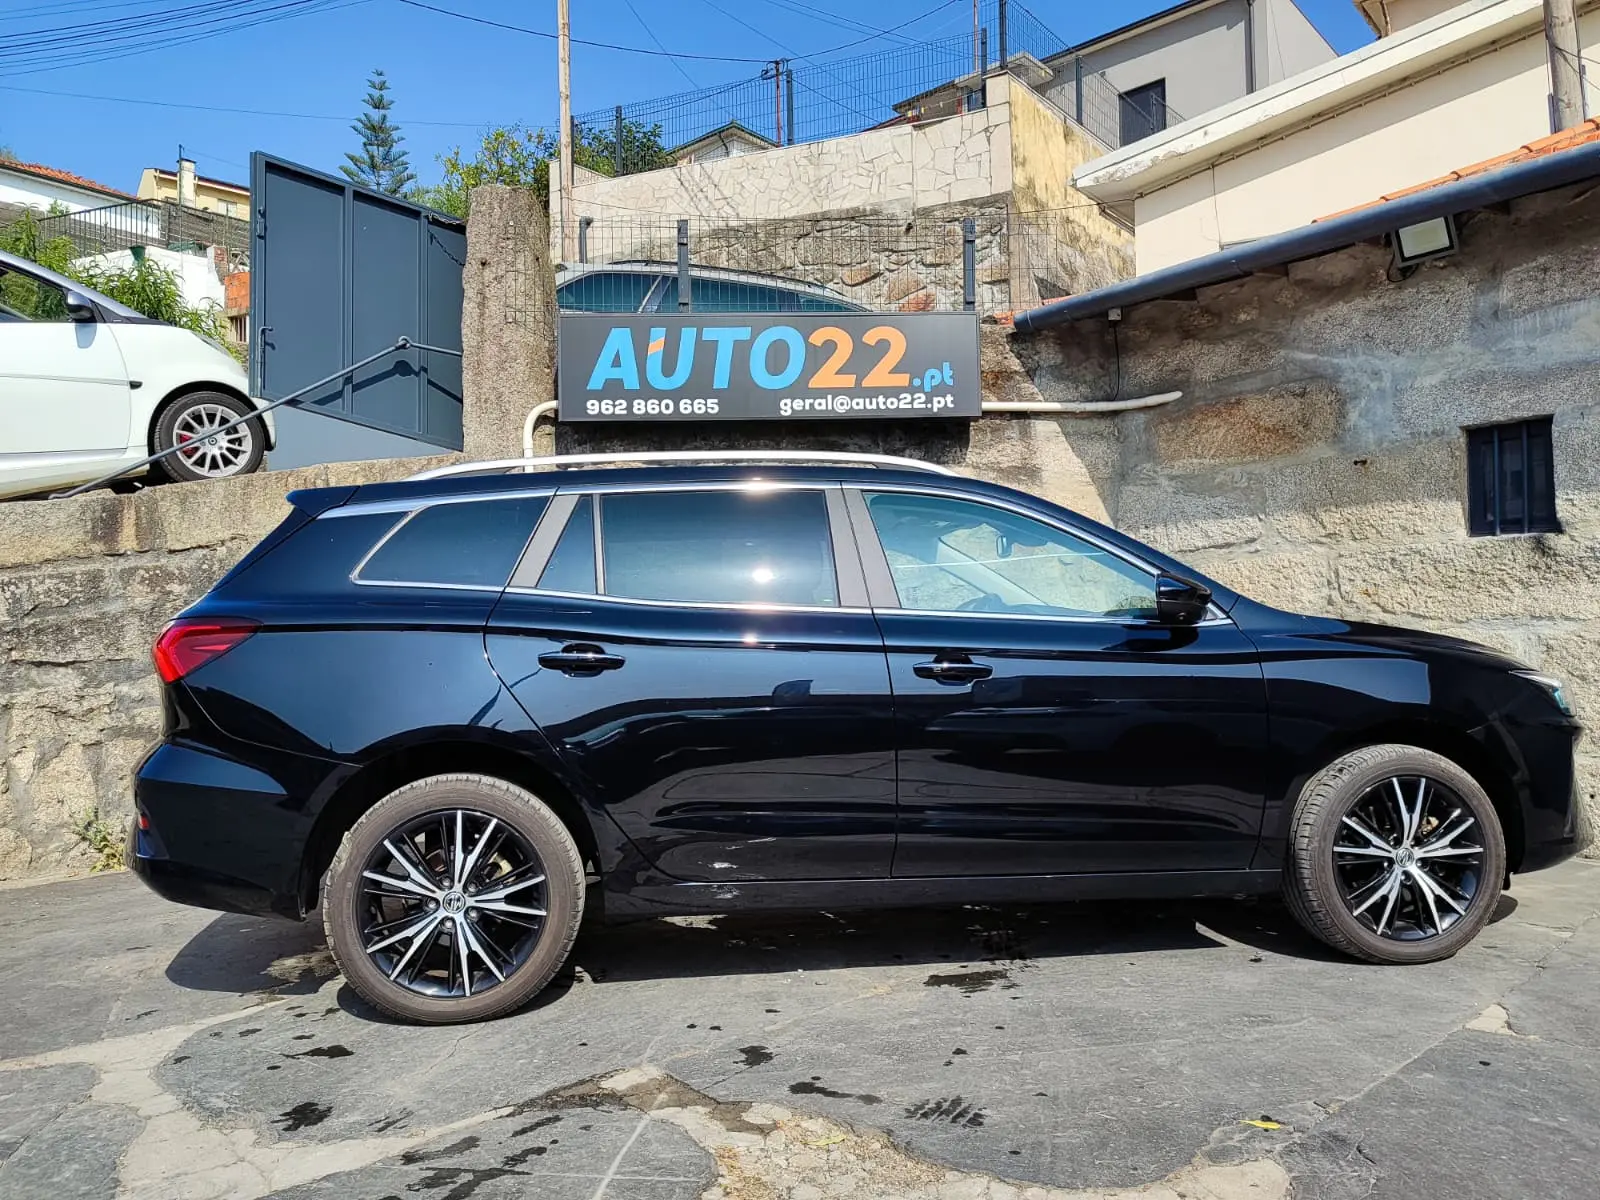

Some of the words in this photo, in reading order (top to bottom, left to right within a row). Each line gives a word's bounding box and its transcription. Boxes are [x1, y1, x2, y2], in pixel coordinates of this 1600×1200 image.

[586, 325, 955, 393] AUTO22.pt
[586, 399, 628, 416] 962
[632, 399, 674, 415] 860
[678, 398, 720, 415] 665
[779, 393, 955, 417] geral@auto22.pt
